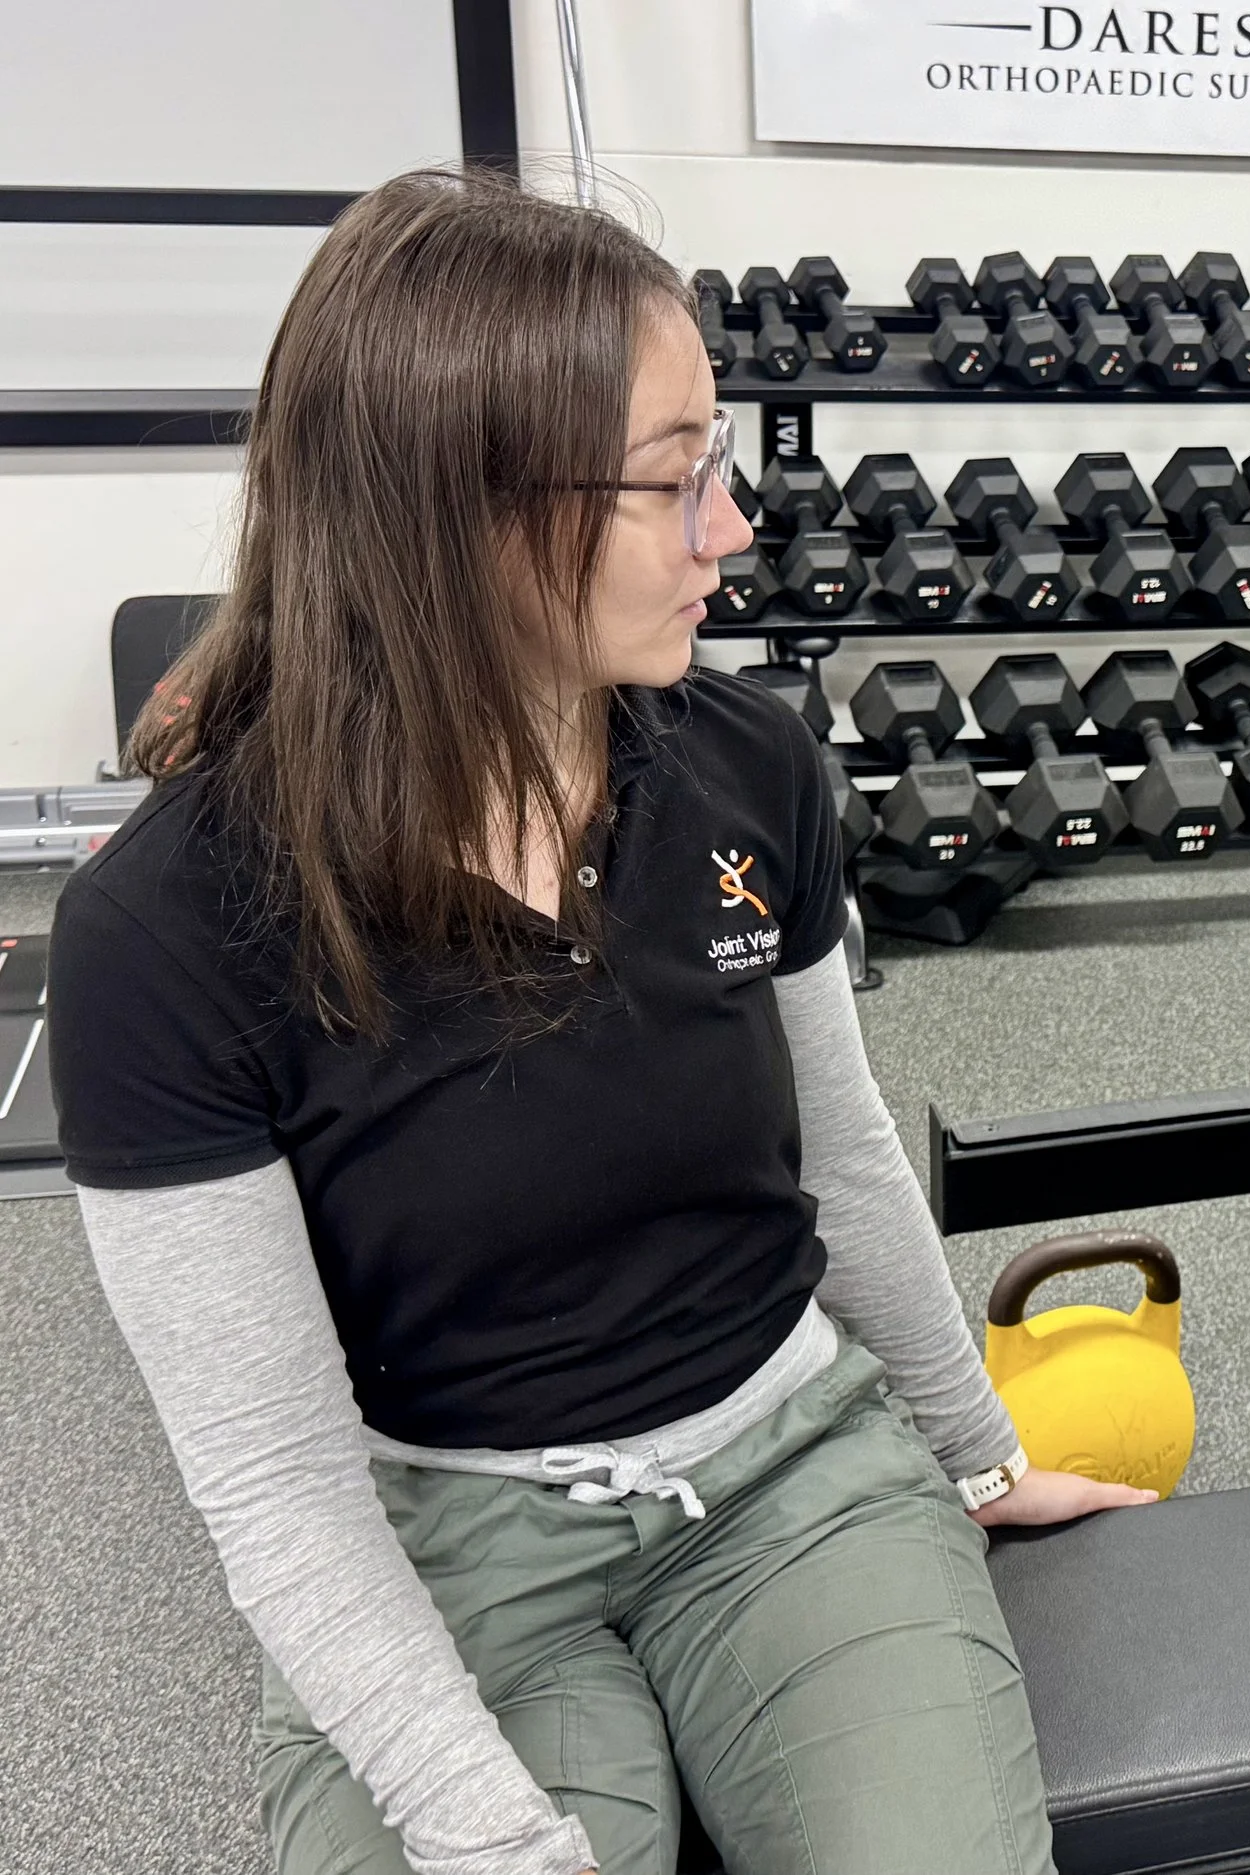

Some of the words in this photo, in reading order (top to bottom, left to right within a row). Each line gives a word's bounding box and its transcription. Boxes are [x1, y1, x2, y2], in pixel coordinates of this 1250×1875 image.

[926, 62, 1194, 99] ORTHOPAEDIC
[776, 412, 800, 457] MAI
[707, 934, 758, 959] Joint
